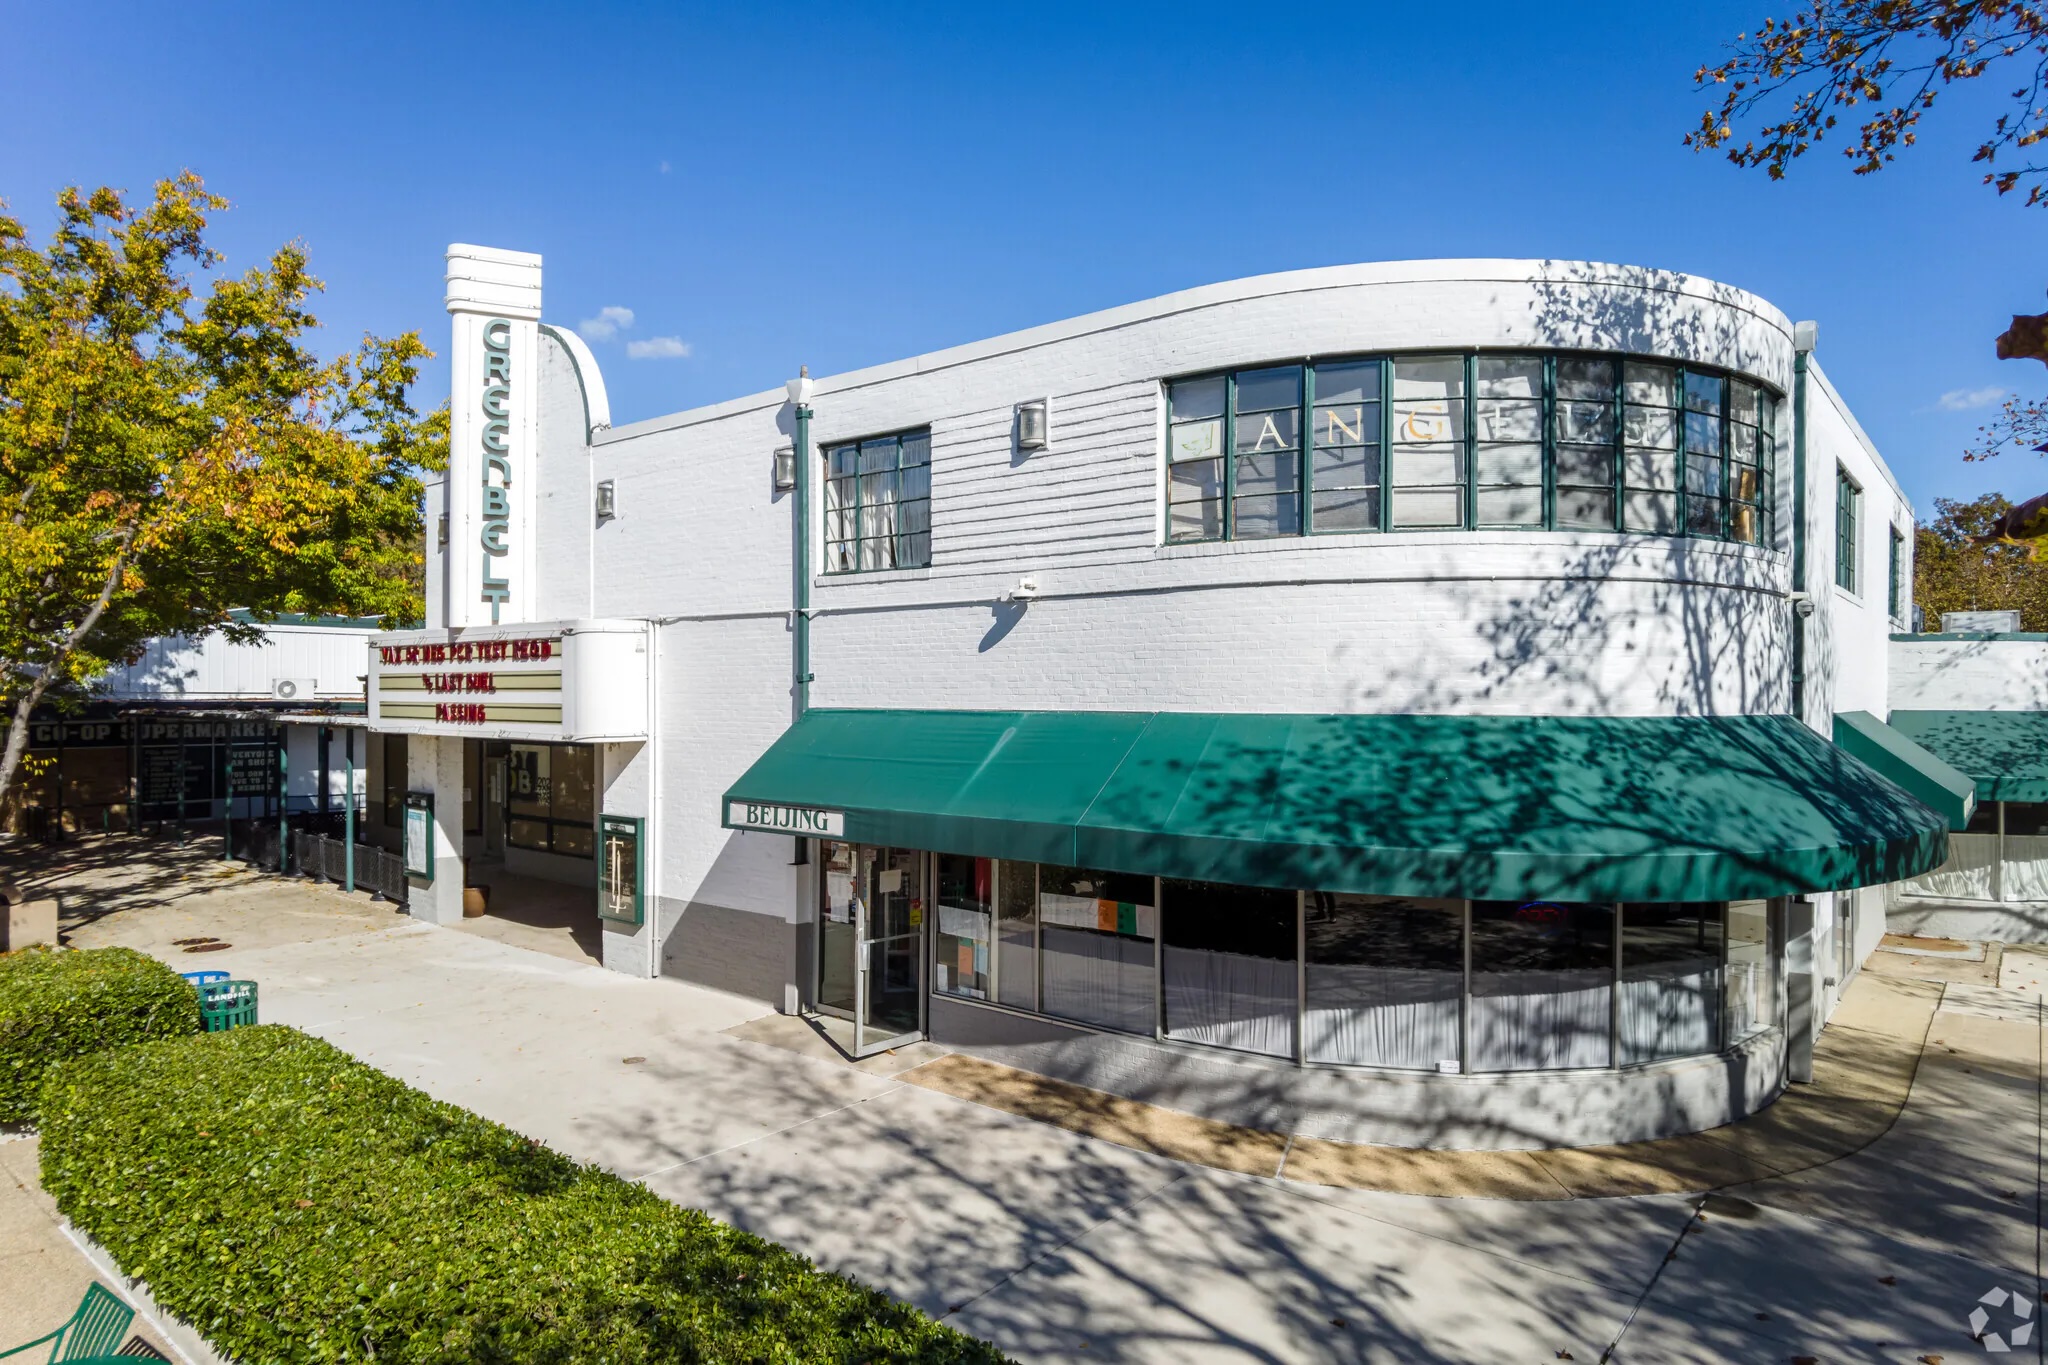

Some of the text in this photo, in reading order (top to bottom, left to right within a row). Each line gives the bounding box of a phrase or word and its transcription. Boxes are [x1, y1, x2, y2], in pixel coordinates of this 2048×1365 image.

[481, 318, 511, 625] GREENBELT
[476, 640, 508, 662] TEST
[435, 672, 464, 693] LAST
[466, 672, 496, 693] DUEL
[36, 724, 111, 741] CO-OP
[746, 804, 828, 831] BEIJING
[208, 991, 251, 1002] LANDFILL
